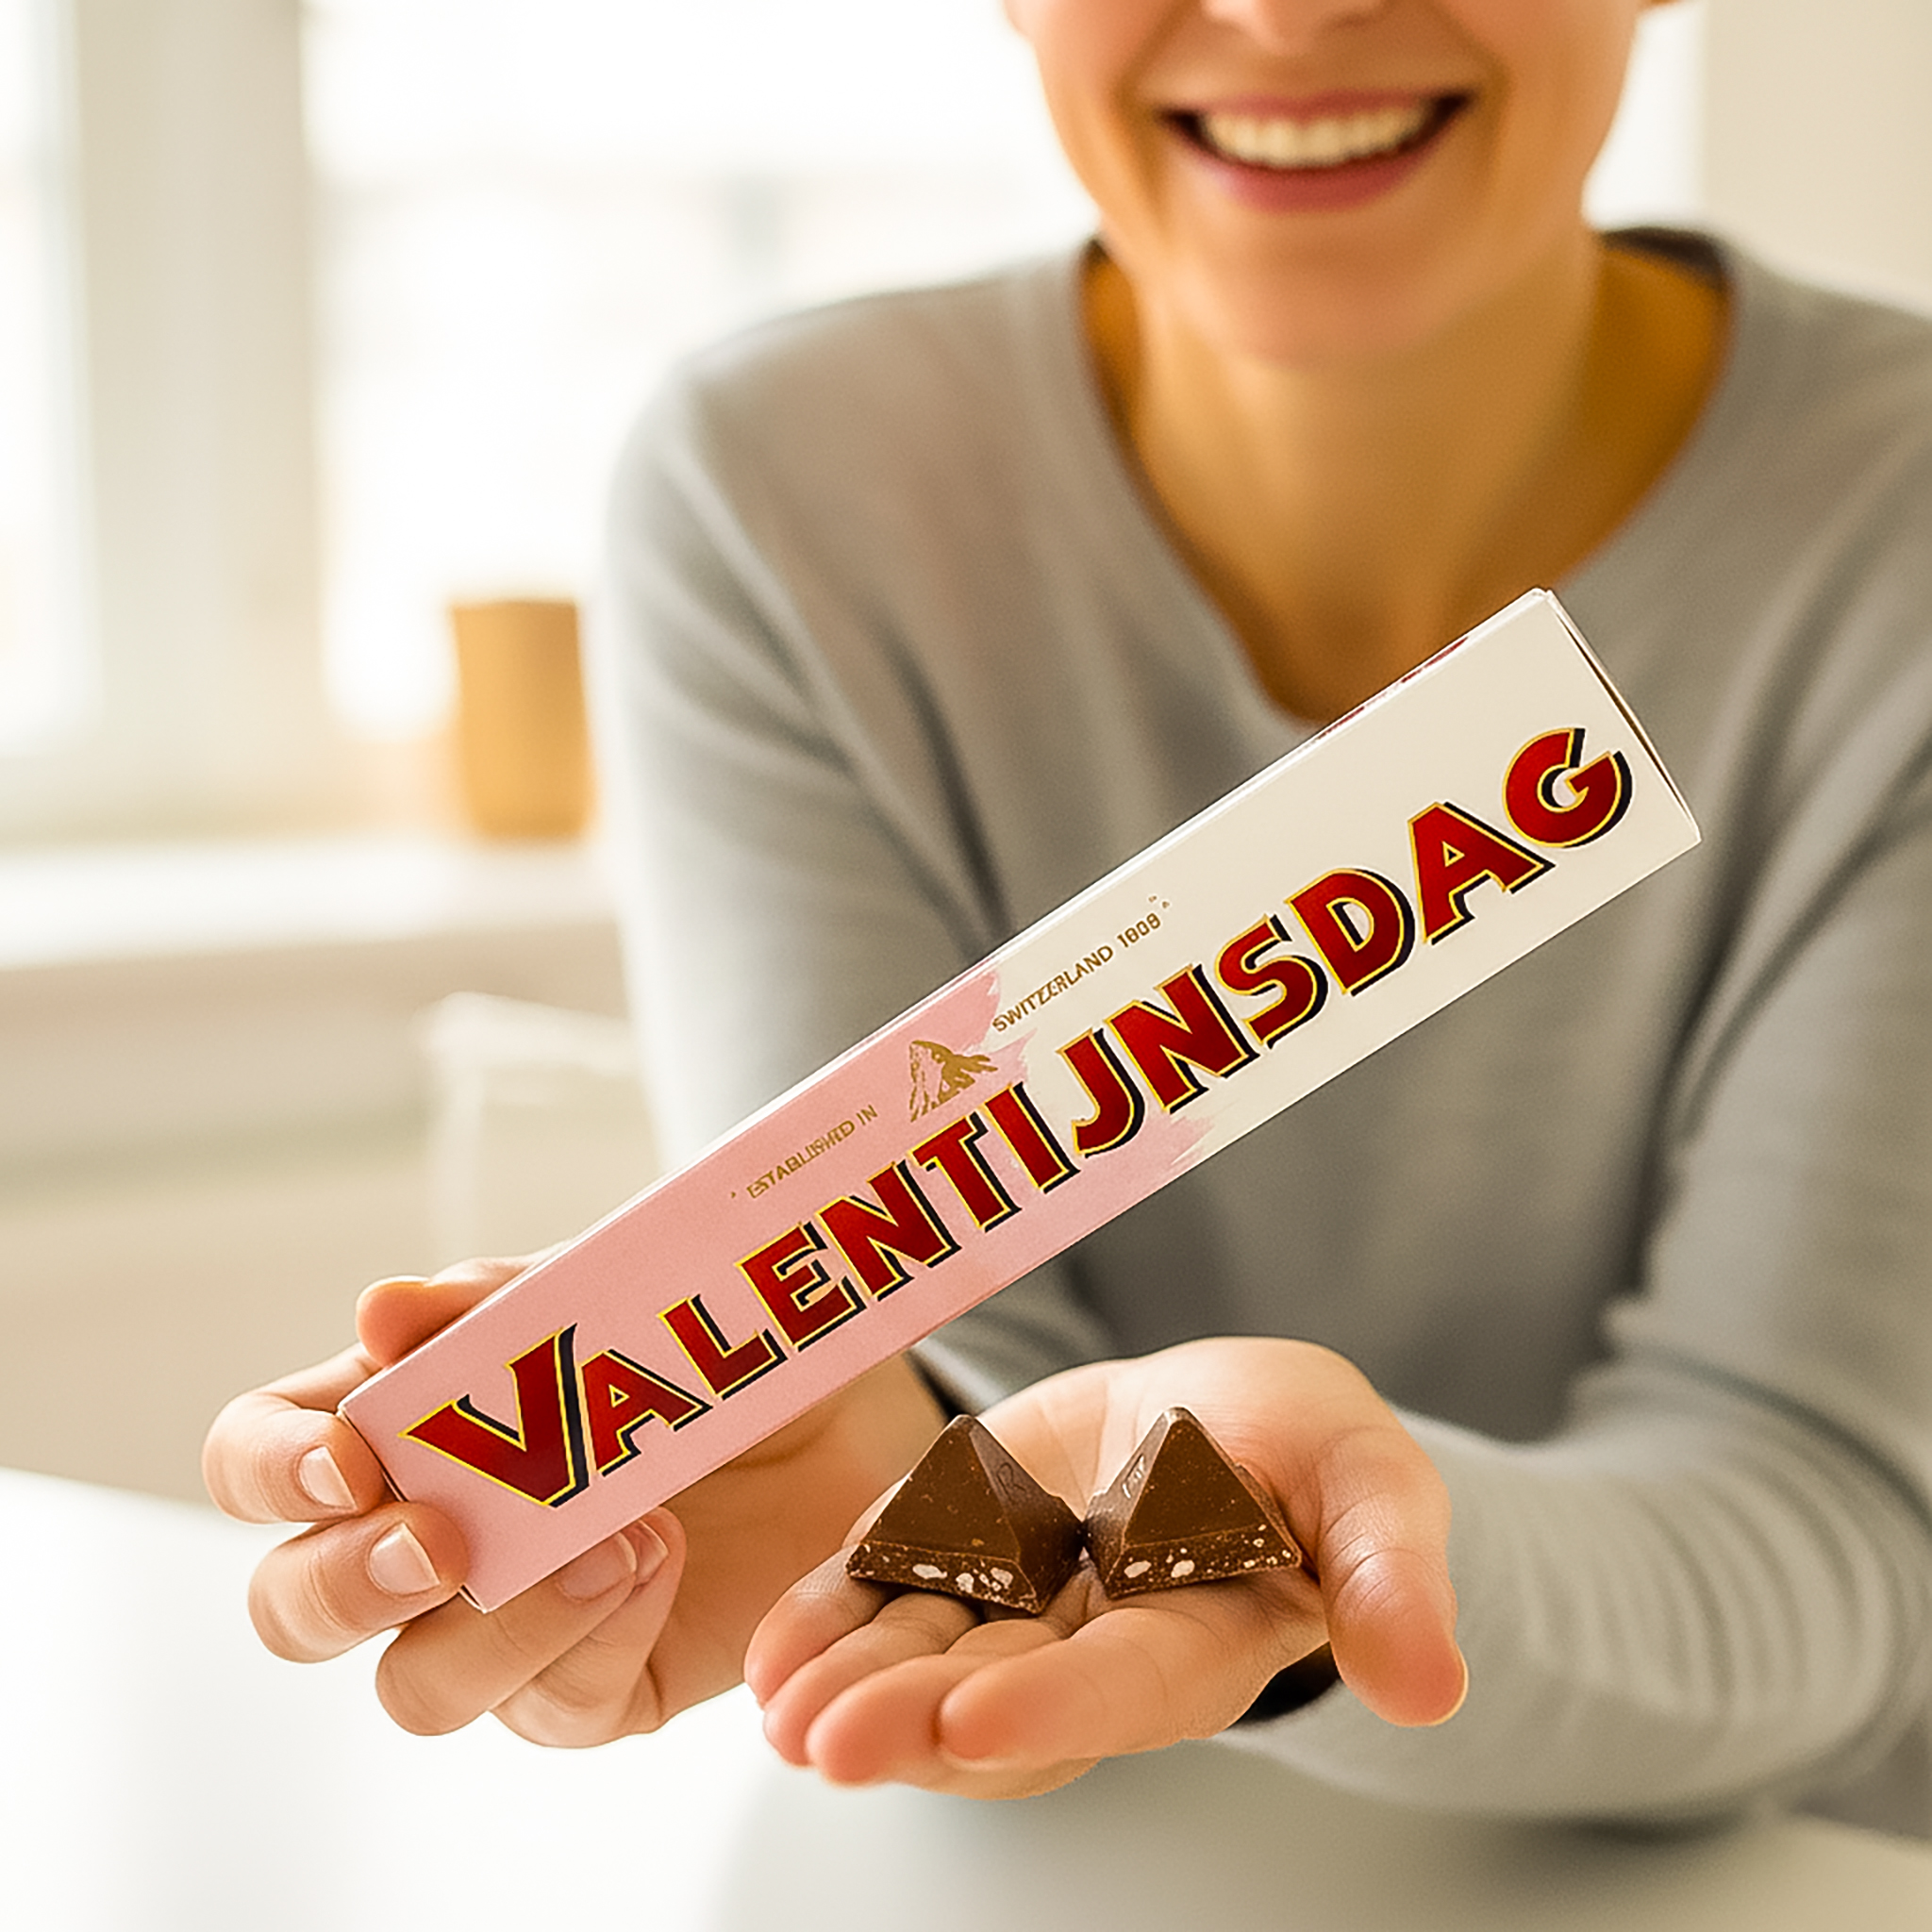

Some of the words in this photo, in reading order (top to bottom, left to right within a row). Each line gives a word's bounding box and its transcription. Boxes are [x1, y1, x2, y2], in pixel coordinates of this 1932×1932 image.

[991, 945, 1113, 1032] SWITZERLAND
[398, 726, 1632, 1507] VALENTIJNSDAG
[856, 1104, 877, 1125] IN
